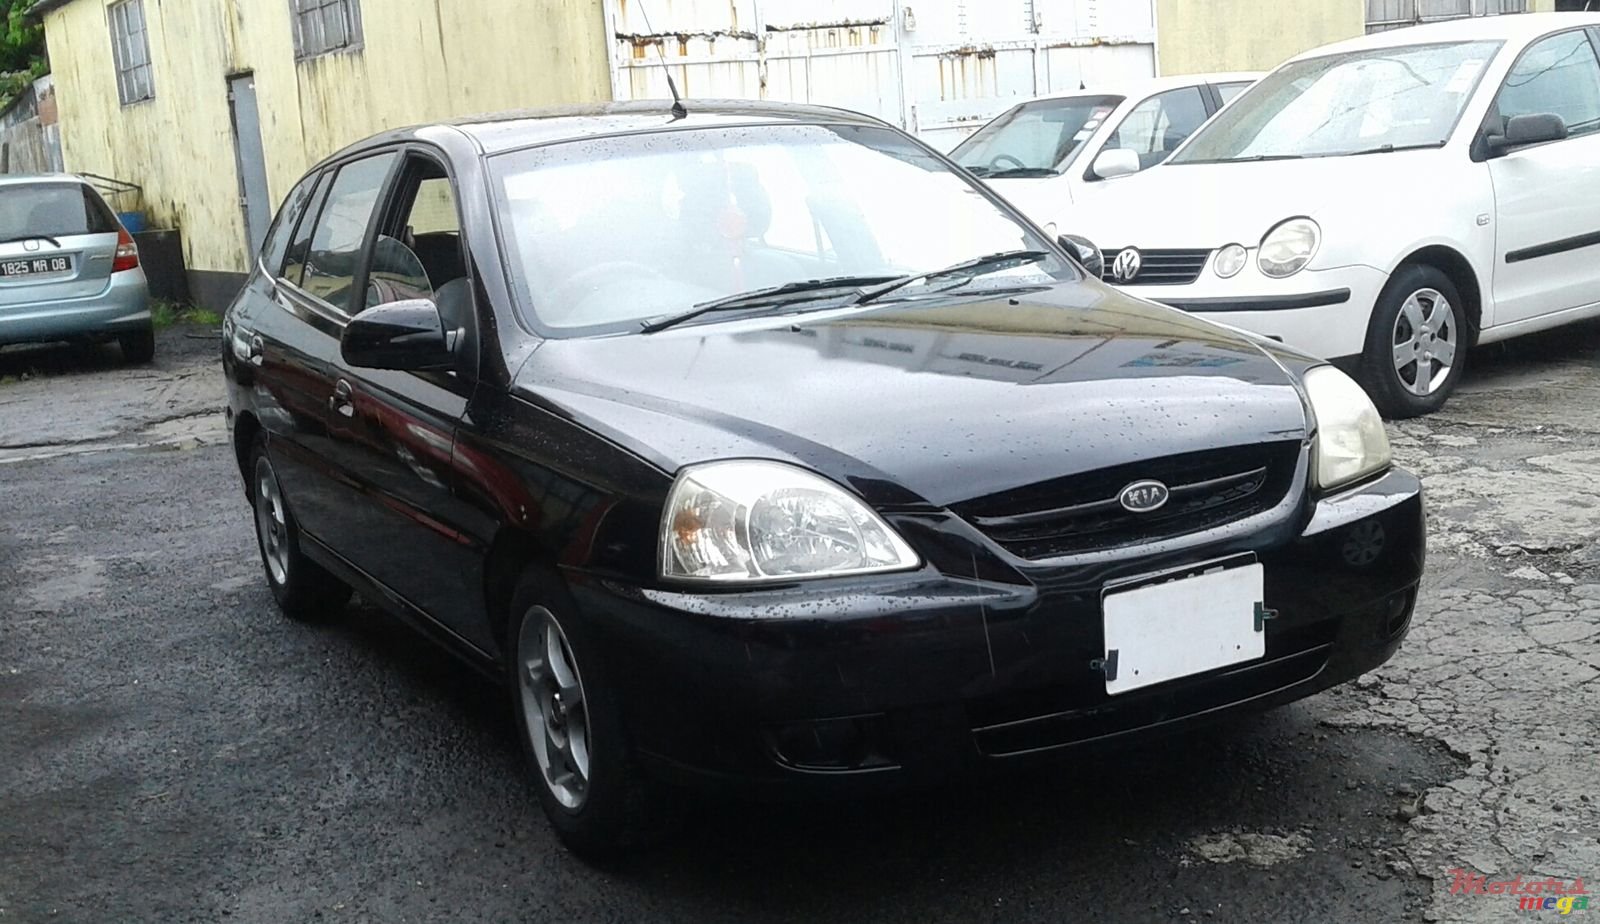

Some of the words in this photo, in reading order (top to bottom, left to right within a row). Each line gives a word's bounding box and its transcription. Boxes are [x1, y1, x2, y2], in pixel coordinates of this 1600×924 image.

[1, 261, 29, 275] 1825
[32, 259, 48, 272] MR
[51, 258, 66, 271] 08
[1127, 487, 1162, 507] KIA
